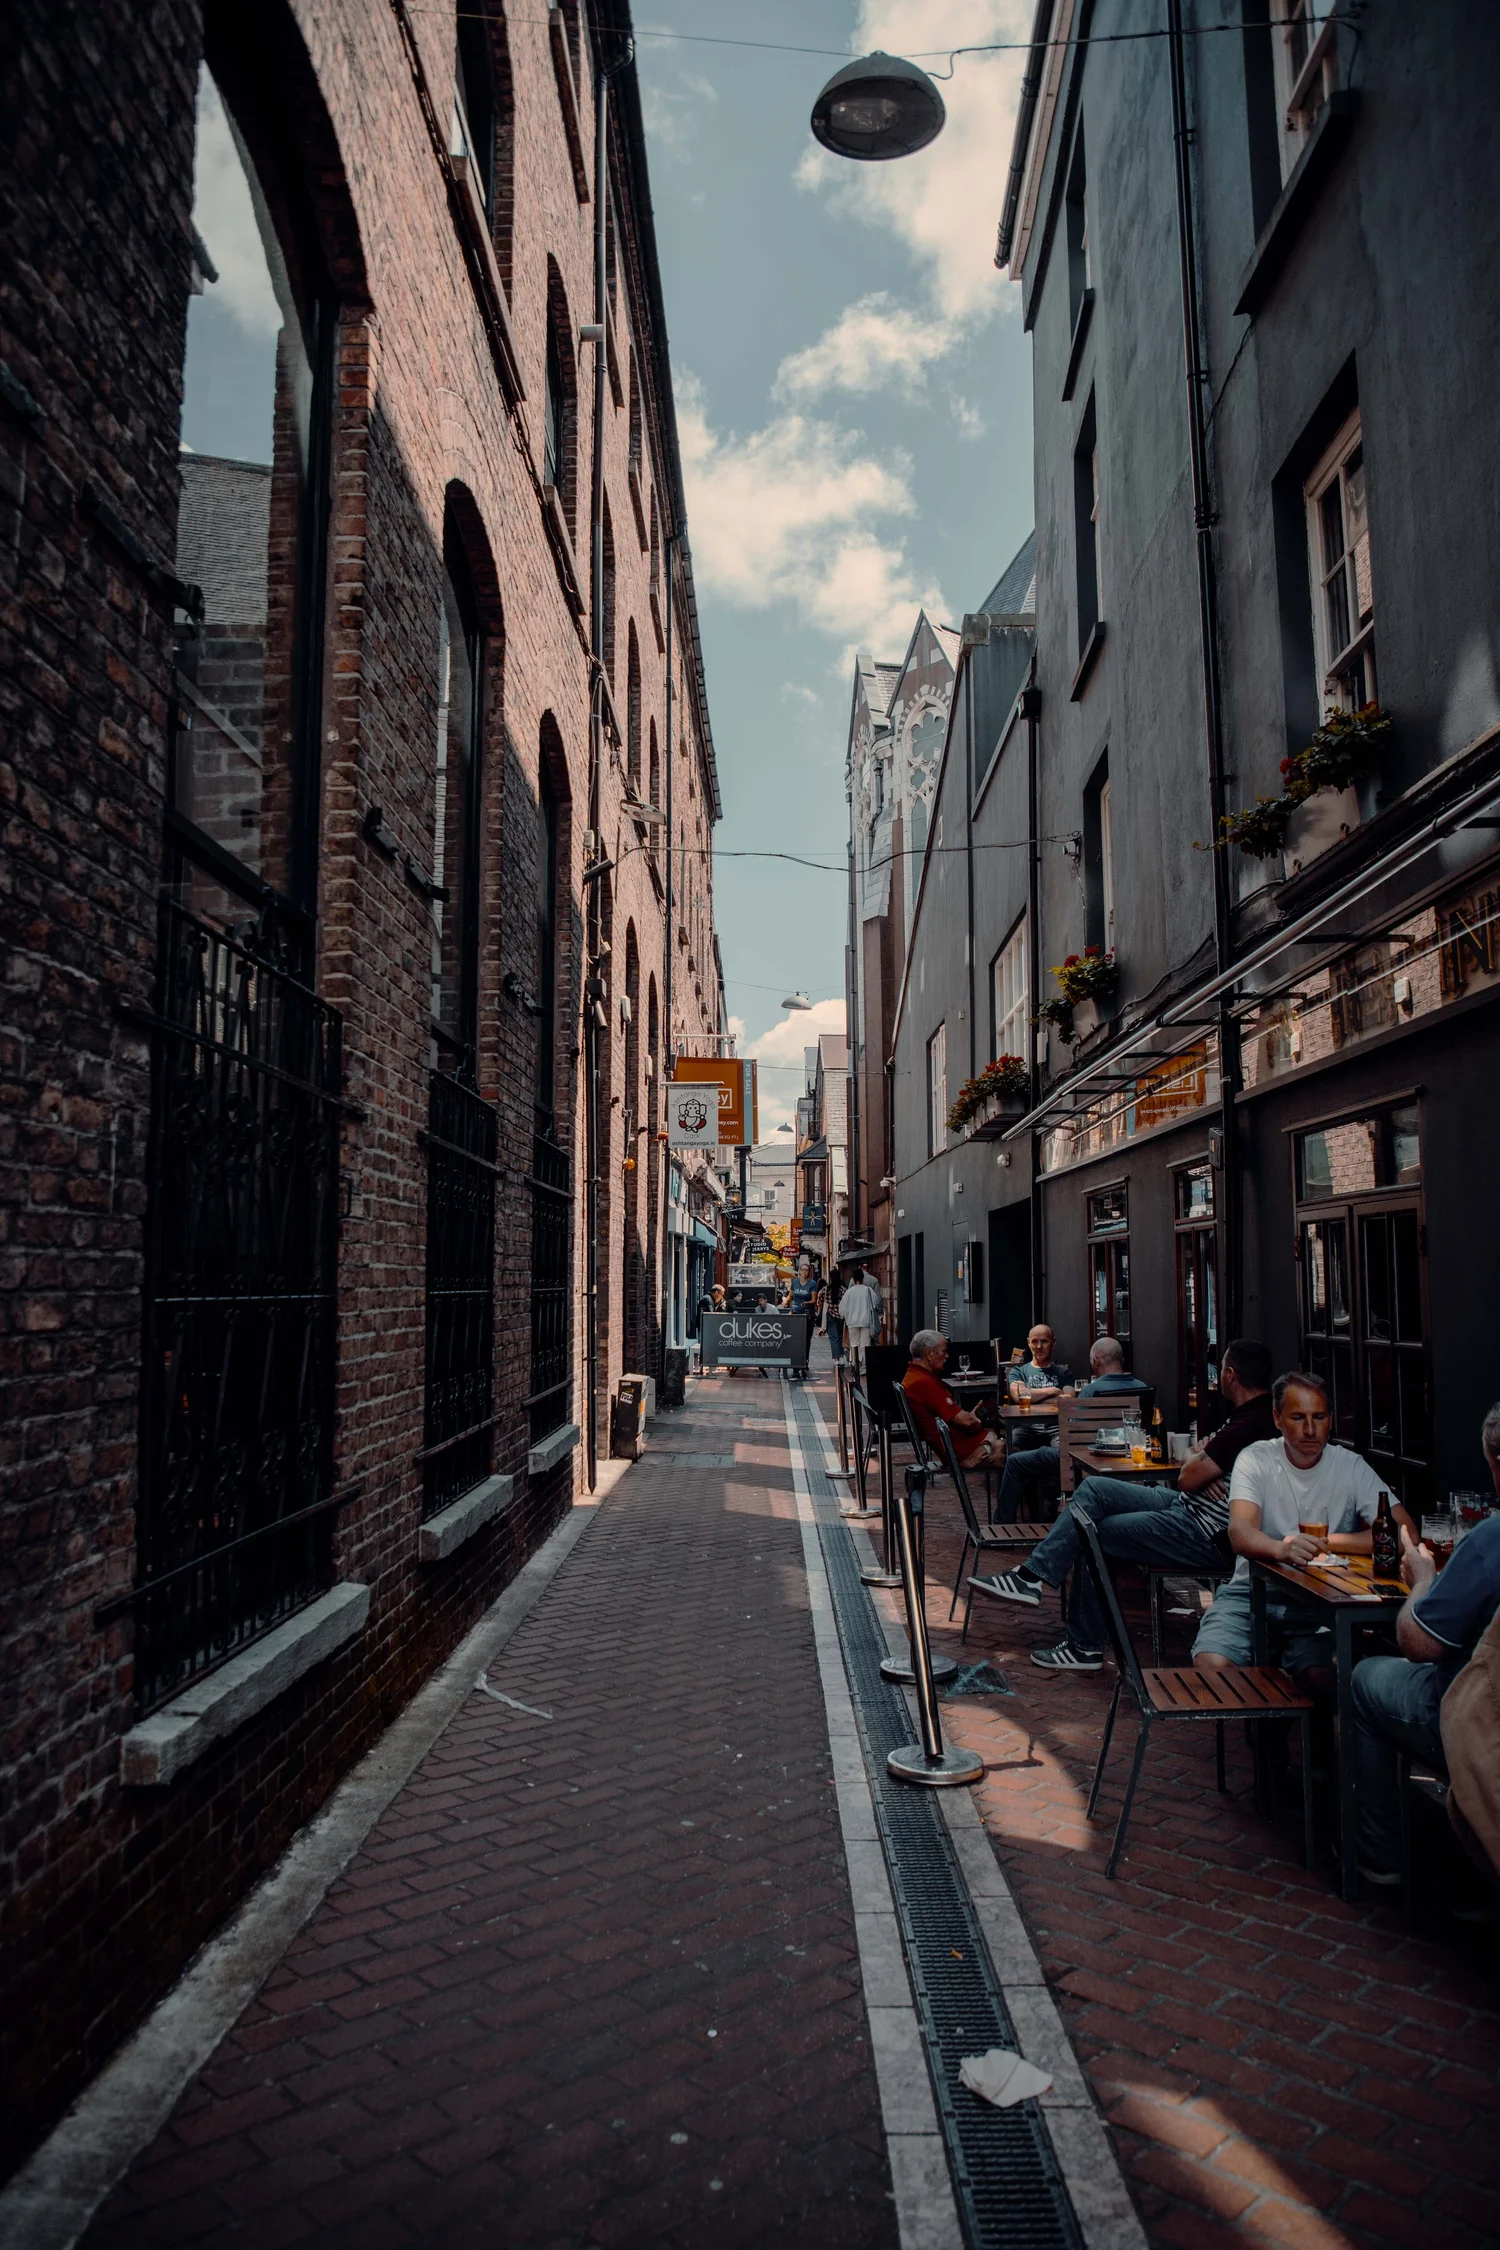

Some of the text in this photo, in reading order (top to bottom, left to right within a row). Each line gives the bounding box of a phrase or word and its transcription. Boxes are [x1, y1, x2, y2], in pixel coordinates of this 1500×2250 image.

[671, 1091, 716, 1110] Ashtanga Yoga
[719, 1317, 782, 1339] dukes
[719, 1338, 784, 1349] coffee company
